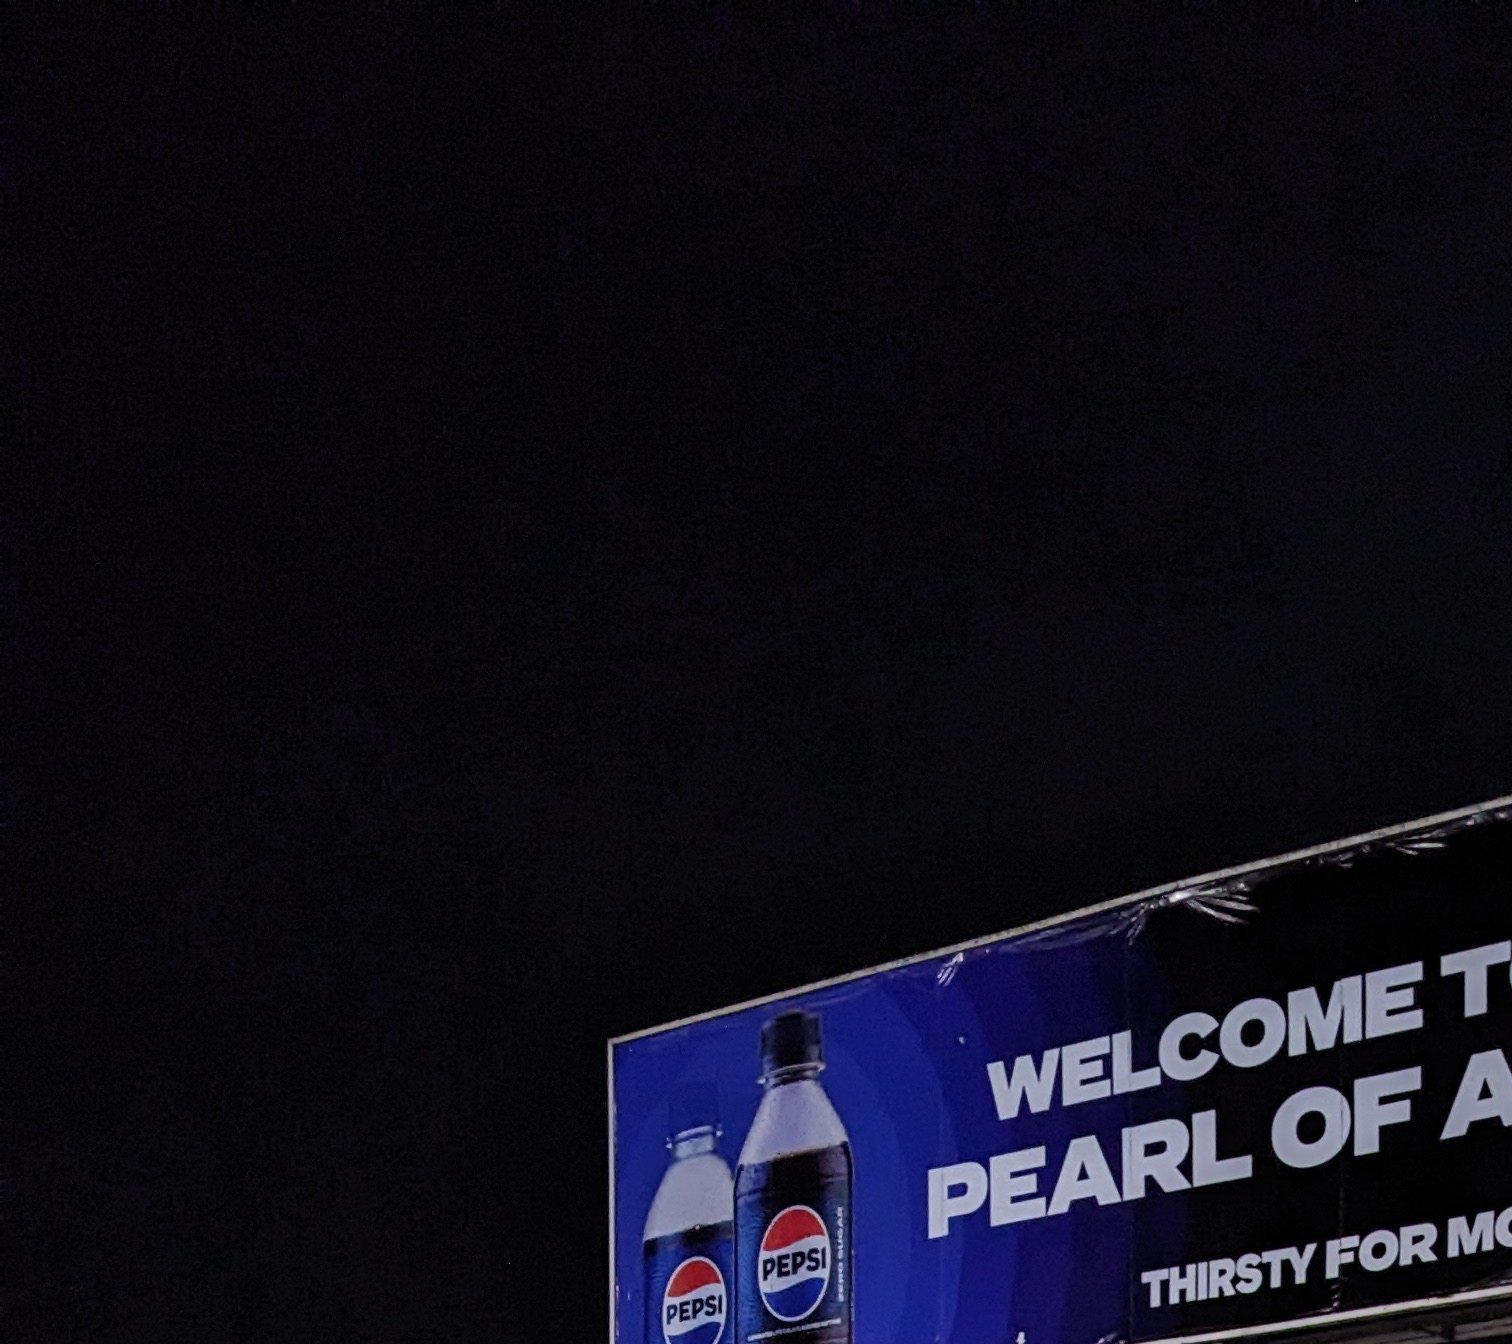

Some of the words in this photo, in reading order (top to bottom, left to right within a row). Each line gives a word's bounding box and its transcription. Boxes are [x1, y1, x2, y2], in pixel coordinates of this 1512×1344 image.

[987, 960, 1424, 1121] WELCOME
[928, 1109, 1253, 1240] PEARL
[1271, 1065, 1422, 1169] OF
[762, 1246, 827, 1281] PEPSI
[1141, 1242, 1317, 1308] THIRSTY
[1325, 1227, 1438, 1280] FOR
[666, 1294, 723, 1325] PEPSI
